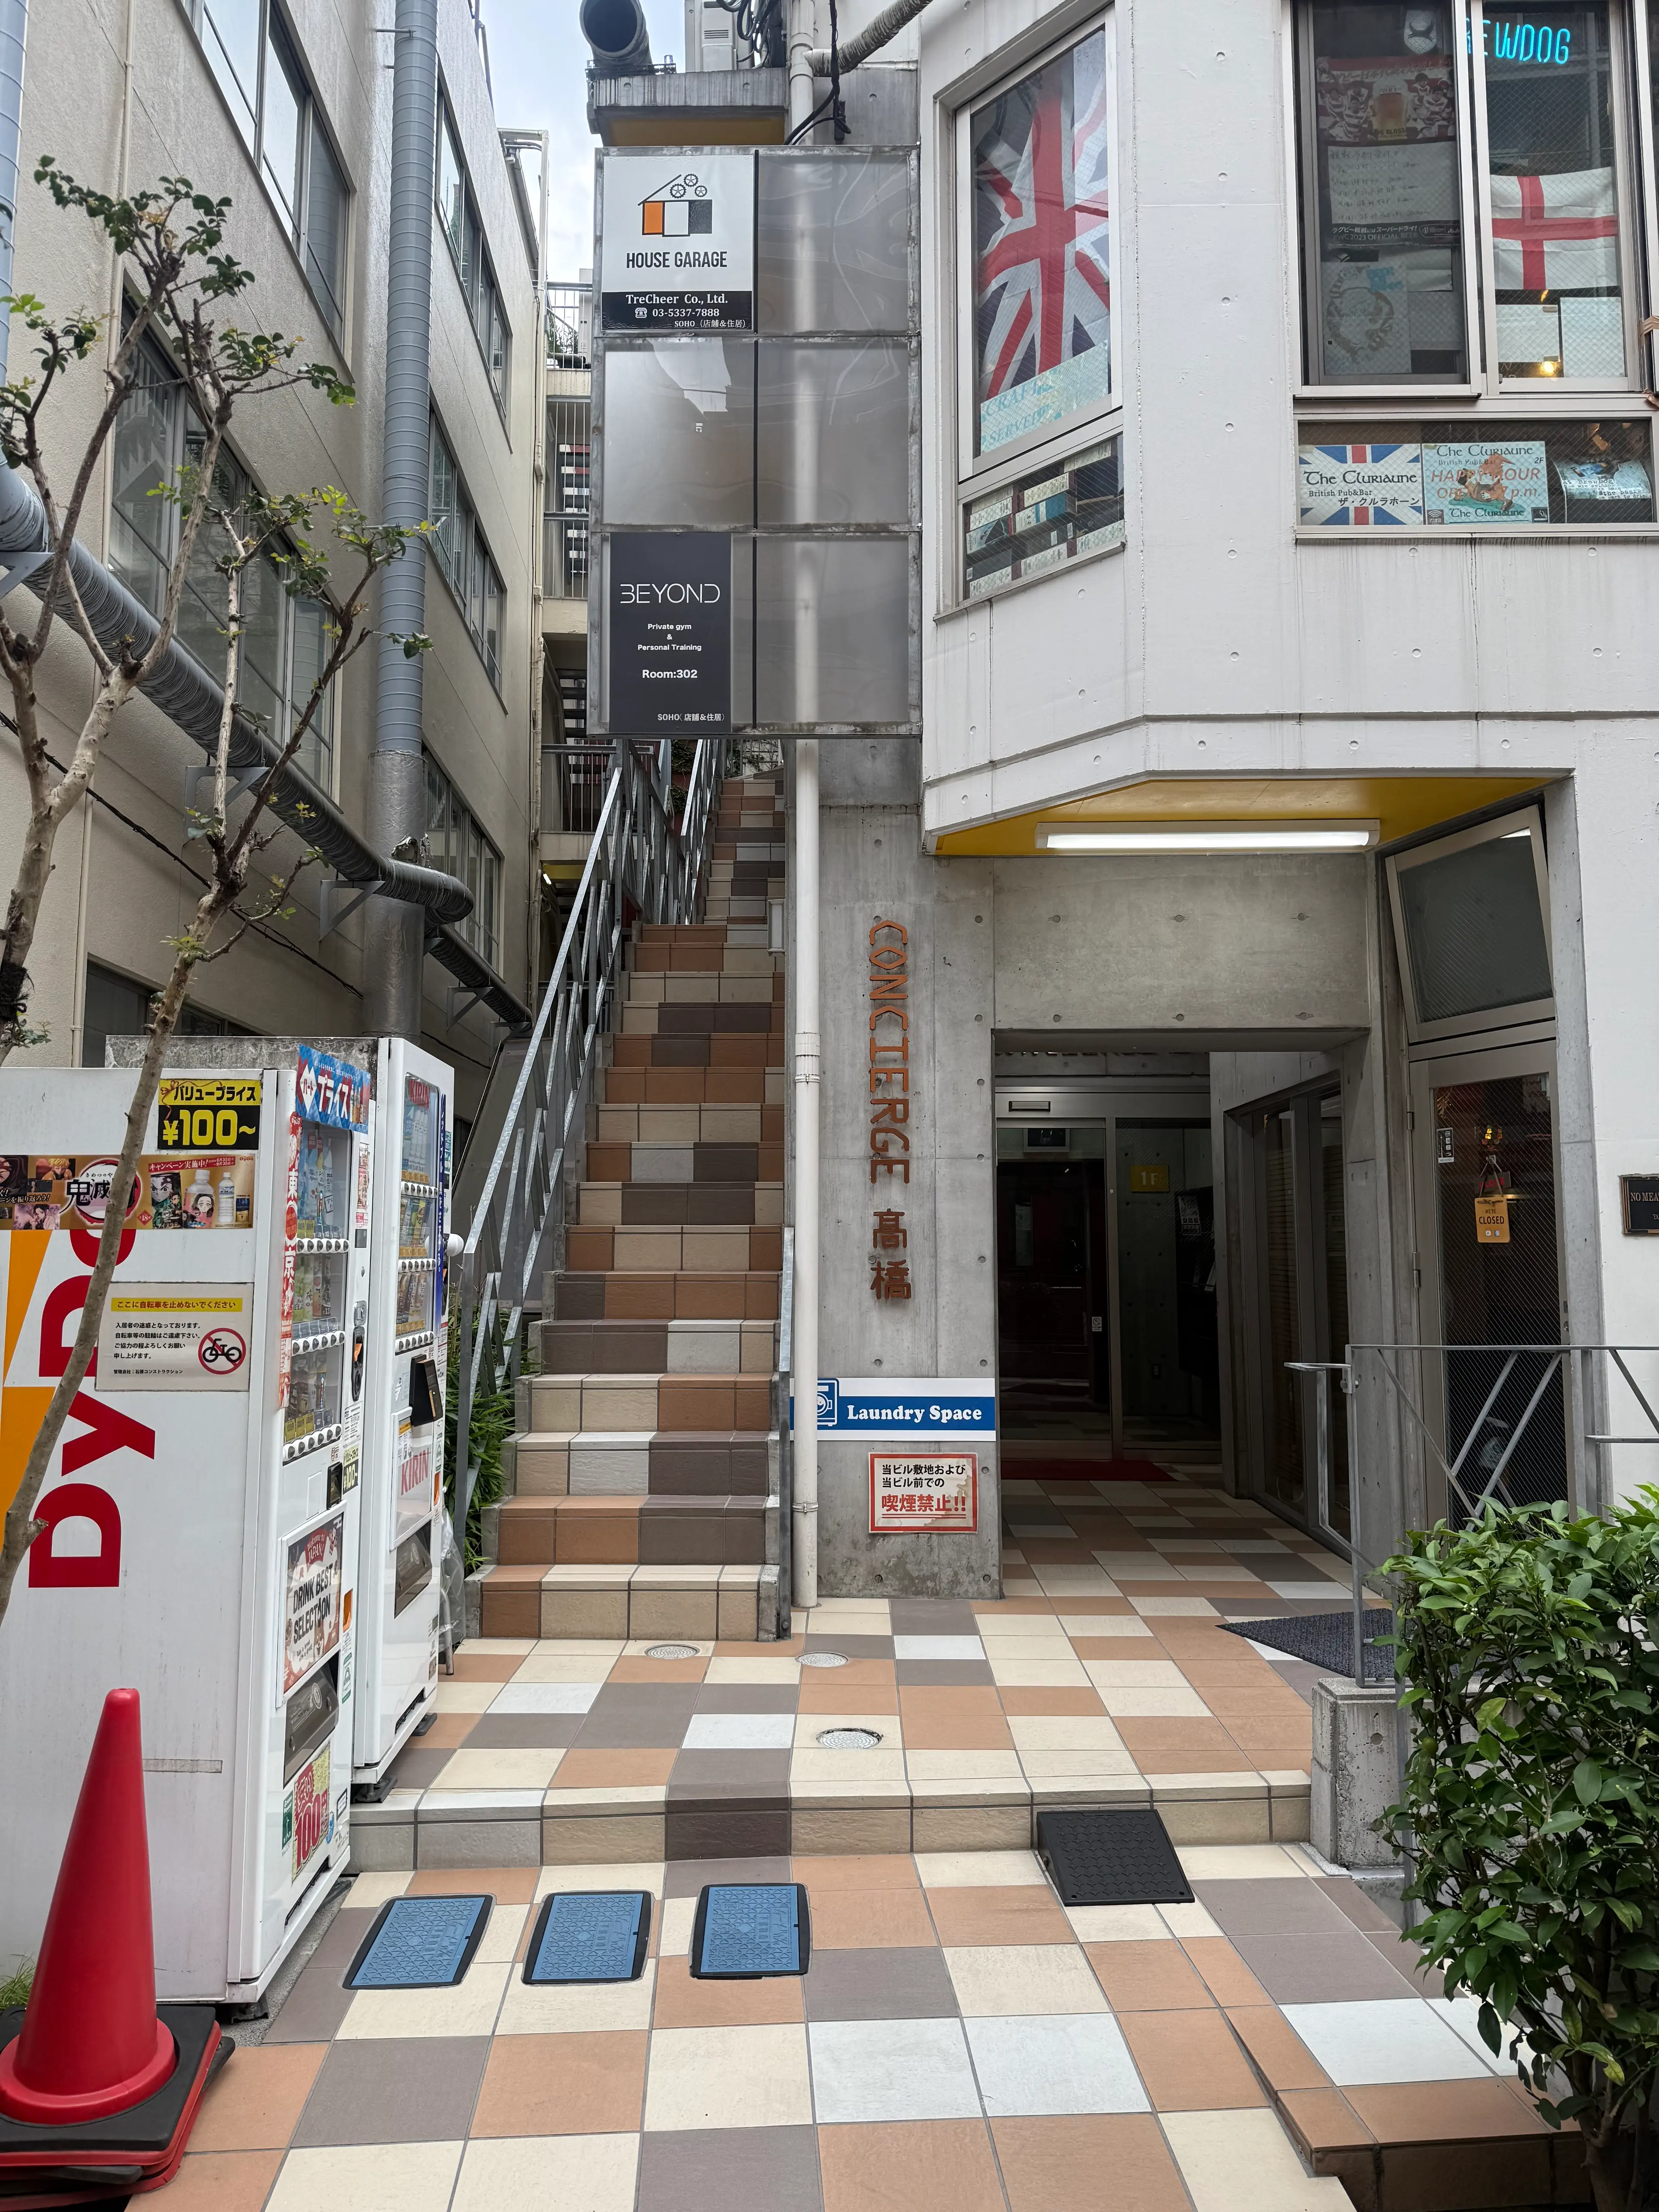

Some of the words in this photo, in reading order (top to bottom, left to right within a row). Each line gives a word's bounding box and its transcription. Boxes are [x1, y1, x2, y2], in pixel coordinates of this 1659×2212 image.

[1466, 17, 1571, 64] EWDOG
[626, 252, 670, 268] HOUSE
[674, 251, 728, 268] GARAGE
[626, 294, 679, 304] TreCheer
[684, 294, 704, 305] Co.,
[707, 294, 728, 304] Ltd.
[652, 308, 720, 317] 03-5337-7888
[1437, 445, 1462, 457] The
[1303, 470, 1337, 485] The
[1343, 470, 1417, 484] Cluriaune
[1338, 497, 1420, 506] ザ・クルラホーン
[1449, 508, 1471, 518] The
[620, 583, 721, 604] BEYOND
[642, 669, 698, 679] Room:302
[869, 919, 909, 1184] CONCIERGE
[174, 1085, 256, 1101] バリュープライス
[318, 1074, 349, 1119] プライス
[409, 1080, 430, 1109] KIRIN
[149, 1159, 208, 1170] キャンペーン実施中!
[1140, 1170, 1158, 1186] 1F
[1630, 1192, 1641, 1201] NO
[1642, 1192, 1659, 1201] MEA
[1479, 1216, 1504, 1224] CLOSED
[847, 1405, 925, 1423] Laundry
[929, 1405, 982, 1423] Space
[401, 1448, 429, 1495] KIRIN
[882, 1464, 966, 1475] 当ビル敷地および
[882, 1477, 945, 1488] 当ビル前での
[881, 1494, 966, 1512] 喫煙禁止!!
[293, 1576, 315, 1615] DRINK
[315, 1563, 334, 1597] BEST
